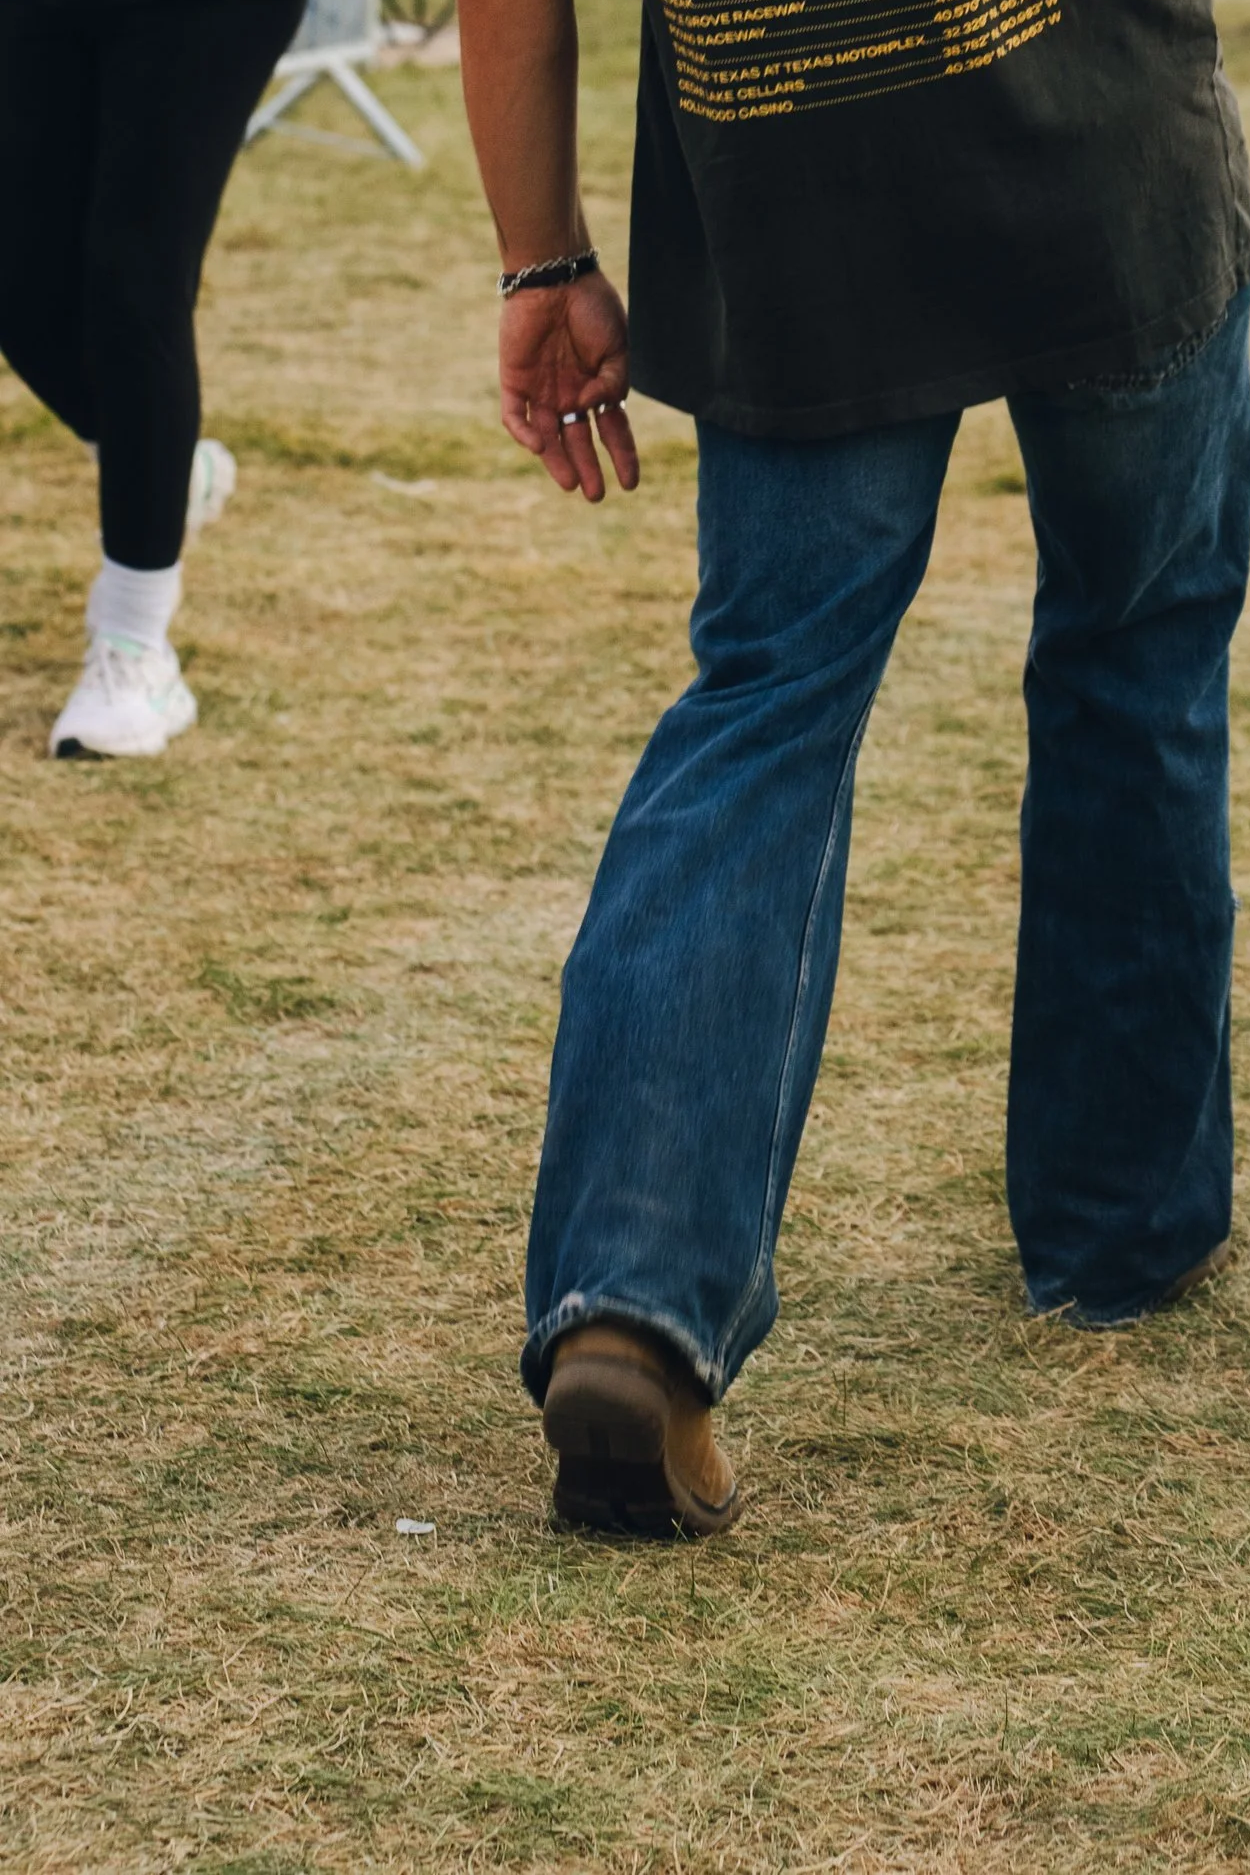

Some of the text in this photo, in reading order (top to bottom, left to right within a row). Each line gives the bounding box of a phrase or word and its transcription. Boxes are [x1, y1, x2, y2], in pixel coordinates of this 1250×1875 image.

[685, 11, 731, 29] GROVE
[732, 0, 806, 26] RACEWAY
[697, 26, 766, 47] RACEWAY
[711, 65, 762, 85] TEXAS
[763, 62, 782, 77] AT
[782, 54, 834, 74] TEXAS
[835, 33, 926, 65] MOTORPLEX
[737, 99, 794, 121] CASINO
[1047, 10, 1062, 26] W
[736, 78, 806, 102] CELLARS
